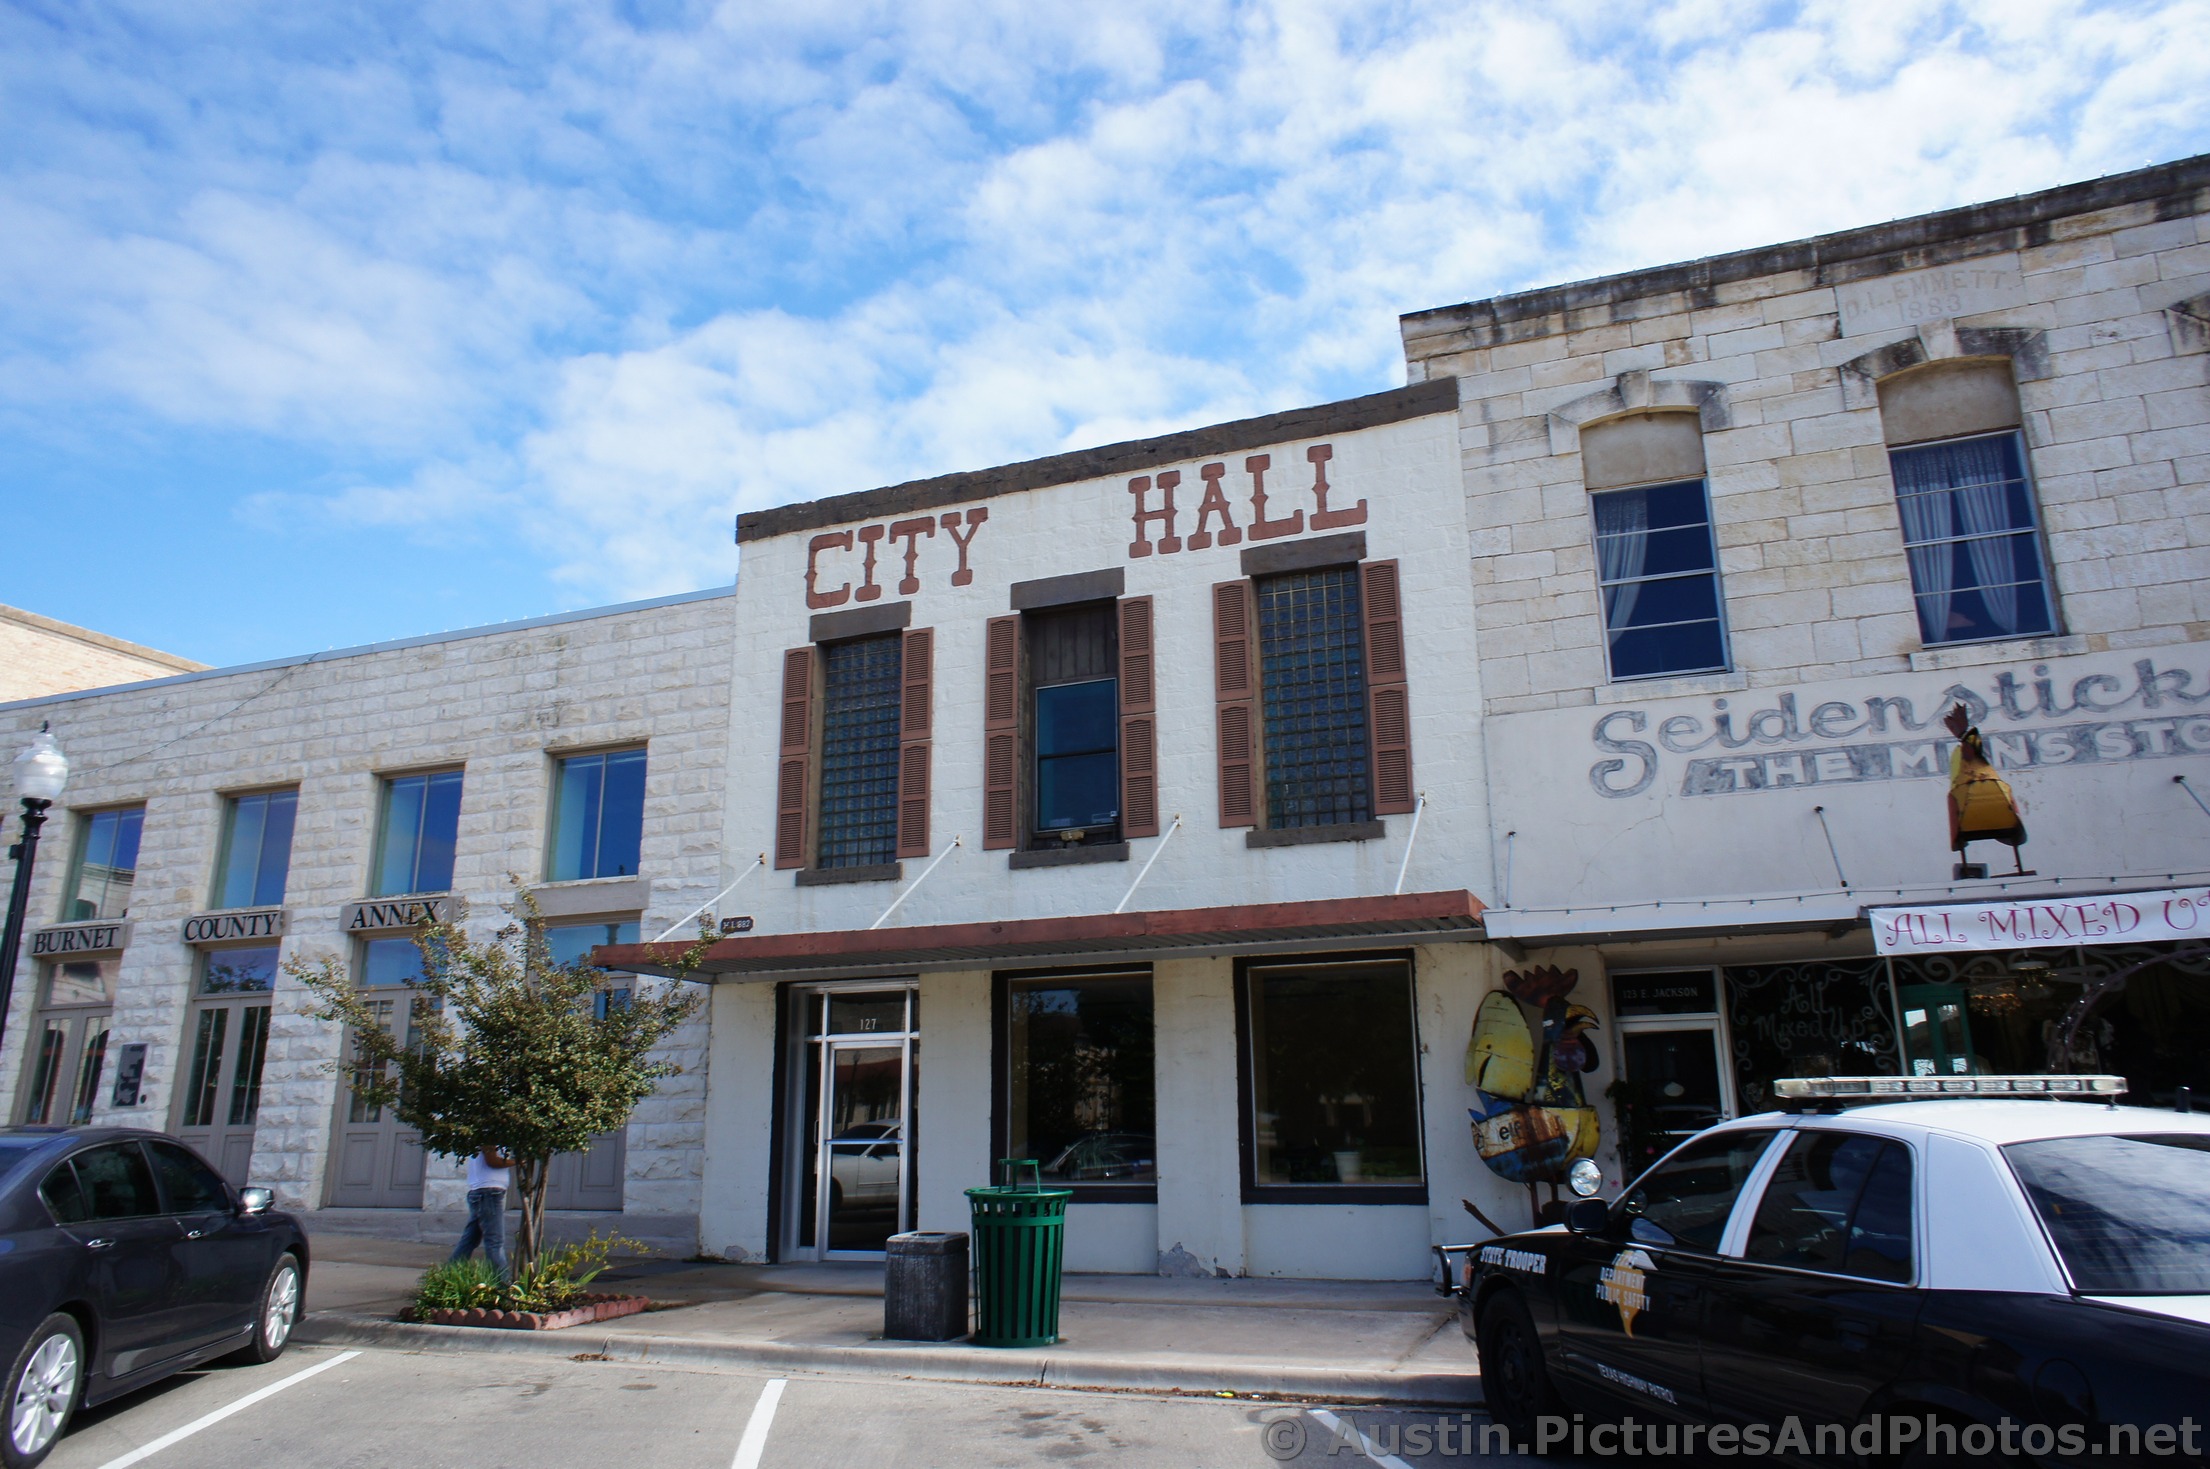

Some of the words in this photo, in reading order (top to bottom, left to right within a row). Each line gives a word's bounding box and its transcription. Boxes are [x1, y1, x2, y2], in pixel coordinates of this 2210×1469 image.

[804, 506, 989, 609] CITY
[1128, 443, 1368, 558] HALL
[1590, 658, 2210, 799] Seidenstick
[1720, 747, 1866, 790] THE
[1889, 728, 2069, 778] MN'S
[184, 913, 279, 942] COUNTY
[350, 900, 440, 929] ANNEX
[1885, 913, 1968, 946] ALL
[1978, 901, 2141, 942] MIXED
[2161, 889, 2210, 931] U
[34, 926, 120, 955] BURNET
[1622, 988, 1638, 999] 123
[1652, 986, 1699, 999] JACKSON
[1780, 980, 1831, 1014] All
[860, 1018, 877, 1030] 127
[1480, 1246, 1505, 1265] STATE
[1504, 1249, 1547, 1275] TROOPER
[1623, 1290, 1650, 1312] SAFETY
